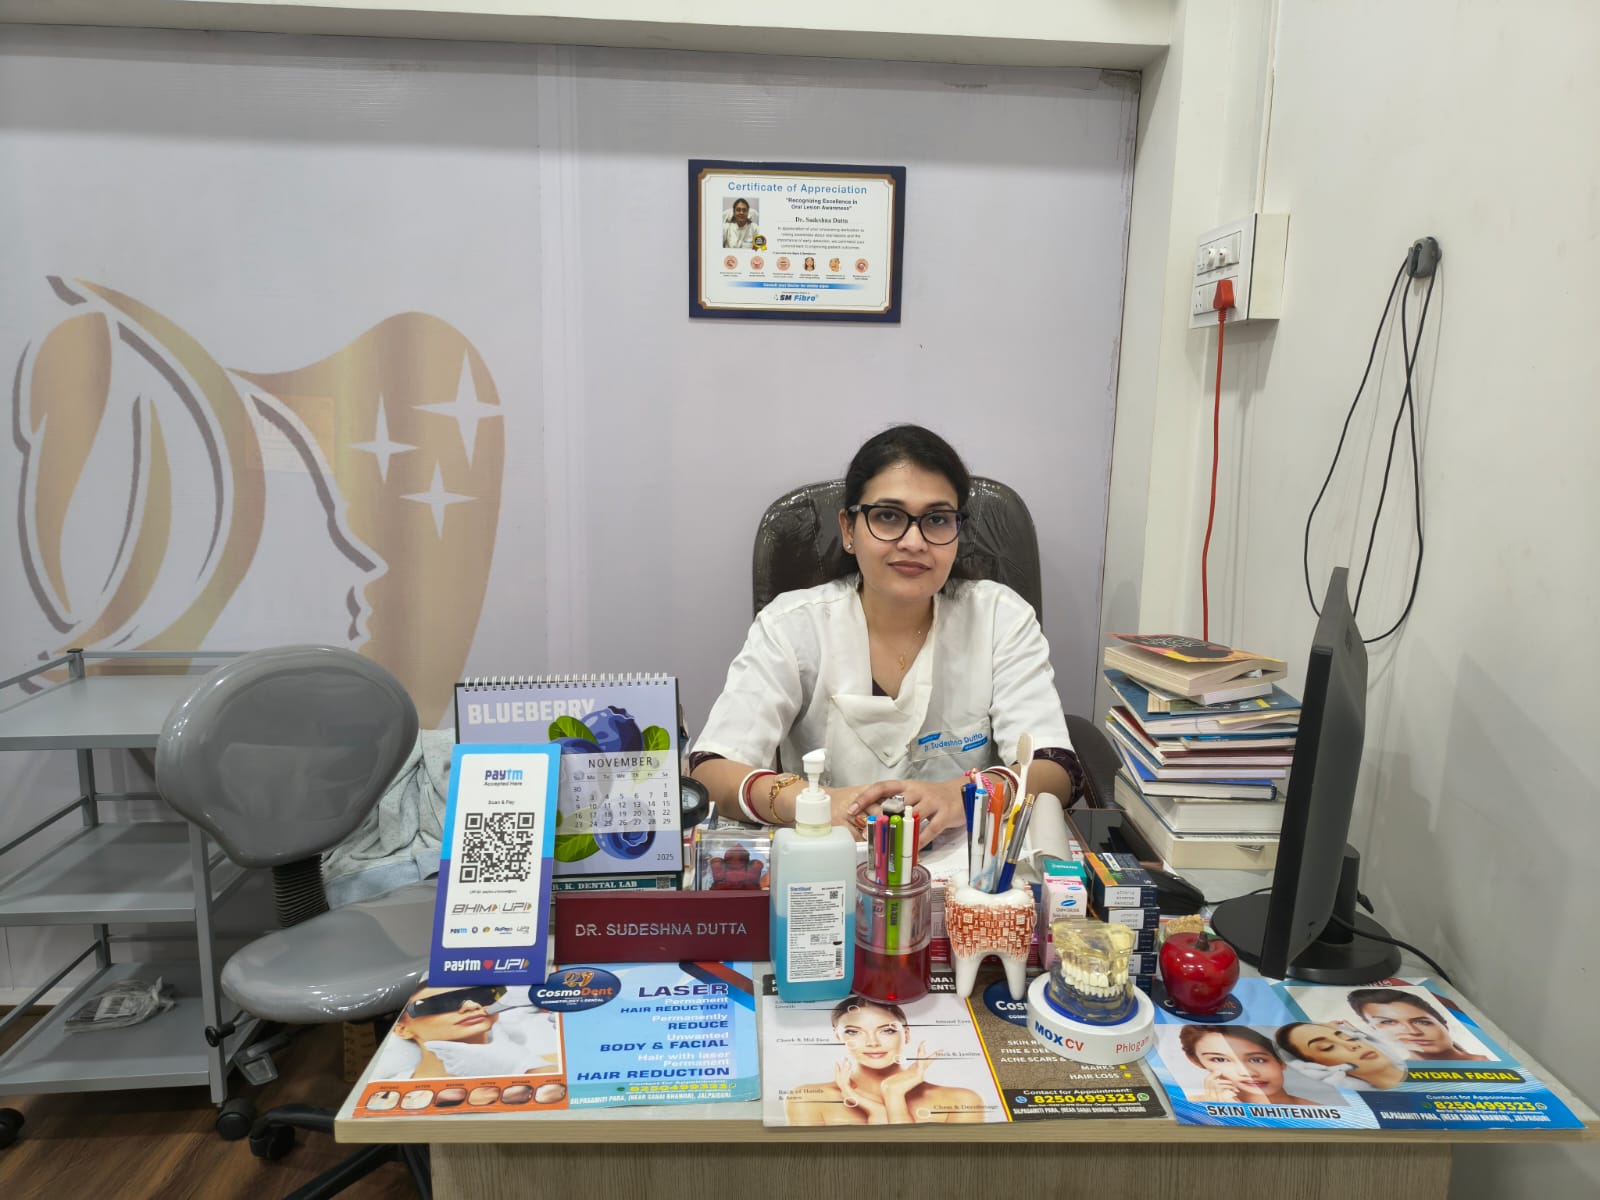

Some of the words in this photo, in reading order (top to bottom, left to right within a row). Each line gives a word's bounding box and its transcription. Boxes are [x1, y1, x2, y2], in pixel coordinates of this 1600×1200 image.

[728, 181, 783, 192] Certificate
[786, 183, 797, 192] of
[800, 183, 867, 195] Appreciation
[468, 699, 595, 725] BLUEBERRY
[963, 733, 983, 743] Dutta
[588, 756, 653, 768] NOVEMBER
[656, 853, 674, 861] 2025
[578, 881, 616, 889] DENTAL
[620, 880, 638, 888] LAB
[452, 904, 492, 914] BHIM
[502, 902, 527, 912] UPI
[575, 923, 602, 937] DR.
[606, 923, 692, 937] SUDESHNA
[697, 922, 747, 936] DUTTA
[494, 957, 525, 971] UPI
[537, 987, 613, 998] CosmoDent
[638, 983, 728, 998] LASER
[664, 997, 728, 1005] Permanent
[655, 1003, 728, 1012] REDUCTION
[651, 1013, 728, 1022] Permanently
[668, 1021, 728, 1030] REDUCE
[667, 1031, 729, 1041] Unwanted
[1035, 1021, 1063, 1047] MOX
[1065, 1038, 1085, 1051] CV
[600, 1042, 646, 1052] BODY
[652, 1042, 664, 1050] &
[670, 1040, 728, 1049] FACIAL
[638, 1053, 663, 1061] Hair
[668, 1052, 694, 1060] with
[699, 1051, 730, 1059] laser
[663, 1059, 730, 1067] Permanent
[577, 1071, 620, 1081] HAIR
[627, 1067, 730, 1078] REDUCTION
[1408, 1071, 1464, 1080] HYDRA
[1464, 1071, 1521, 1081] FACIAL
[1033, 1093, 1137, 1104] 8250499323
[1207, 1105, 1245, 1117] SKIN
[1434, 1101, 1536, 1112] 8250499323
